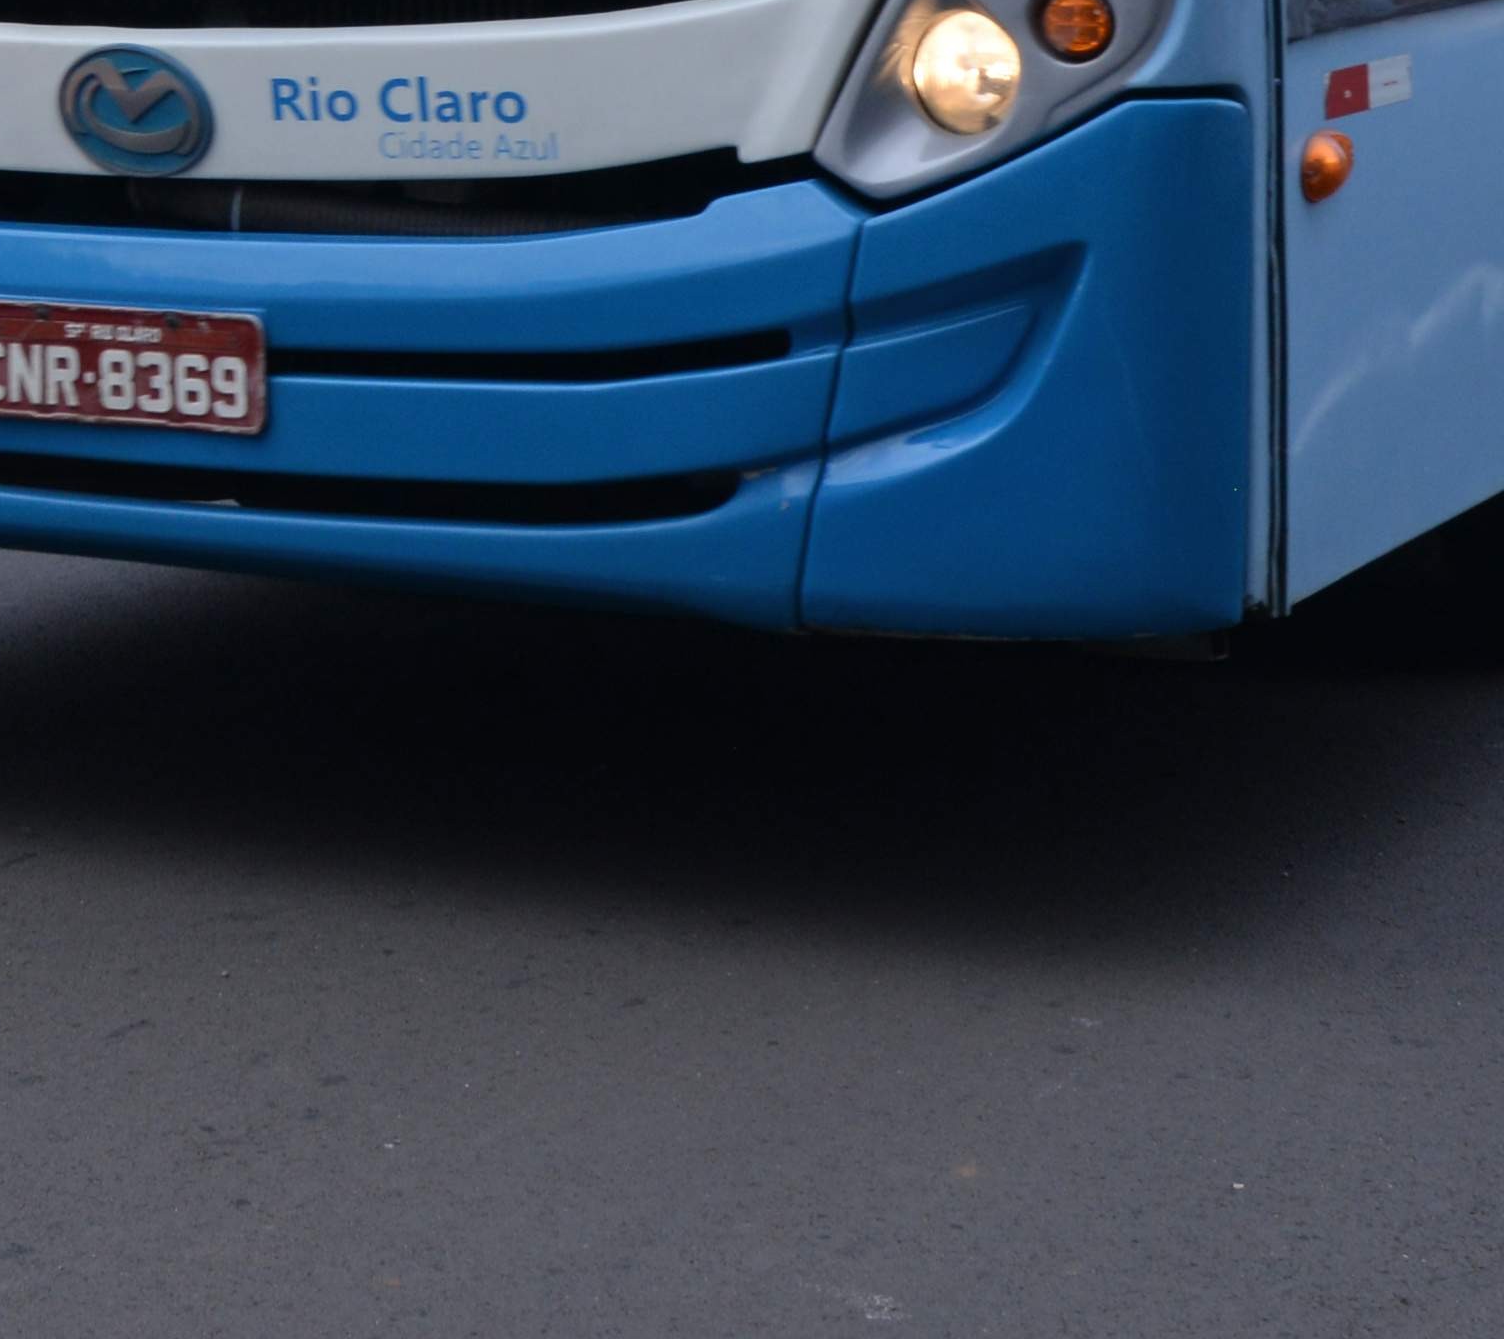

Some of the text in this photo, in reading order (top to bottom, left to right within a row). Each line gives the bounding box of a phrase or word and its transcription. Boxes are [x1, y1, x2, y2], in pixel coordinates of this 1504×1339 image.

[271, 76, 528, 124] Rio Claro
[378, 131, 560, 161] Cidade Azul
